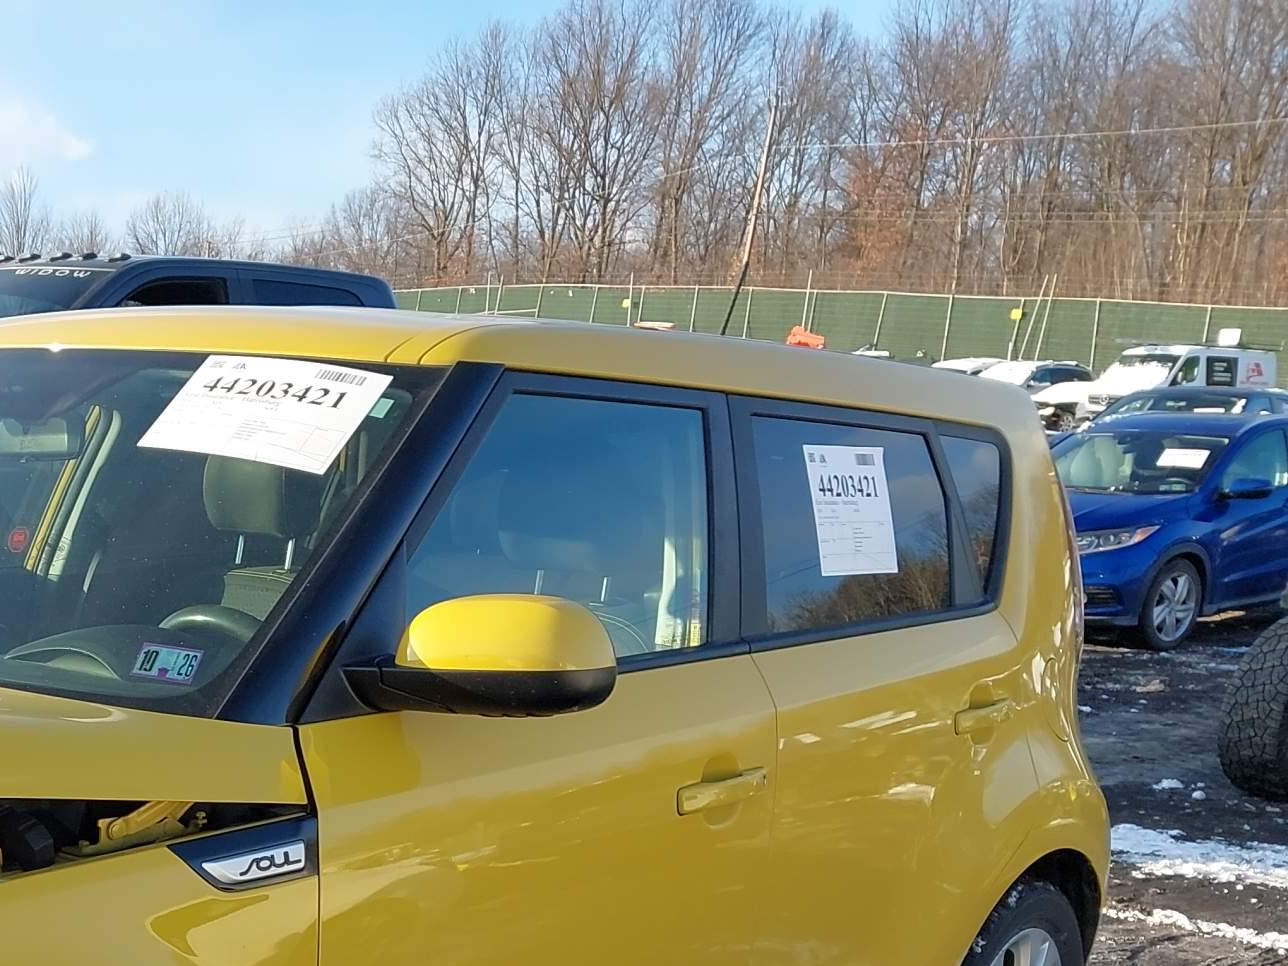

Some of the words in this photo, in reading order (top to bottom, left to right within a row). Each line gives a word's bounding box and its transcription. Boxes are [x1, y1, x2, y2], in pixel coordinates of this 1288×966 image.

[202, 376, 348, 409] 44203421
[817, 473, 880, 498] 44203421
[137, 648, 160, 673] 10
[176, 653, 199, 678] 26
[238, 850, 303, 877] SOUL
